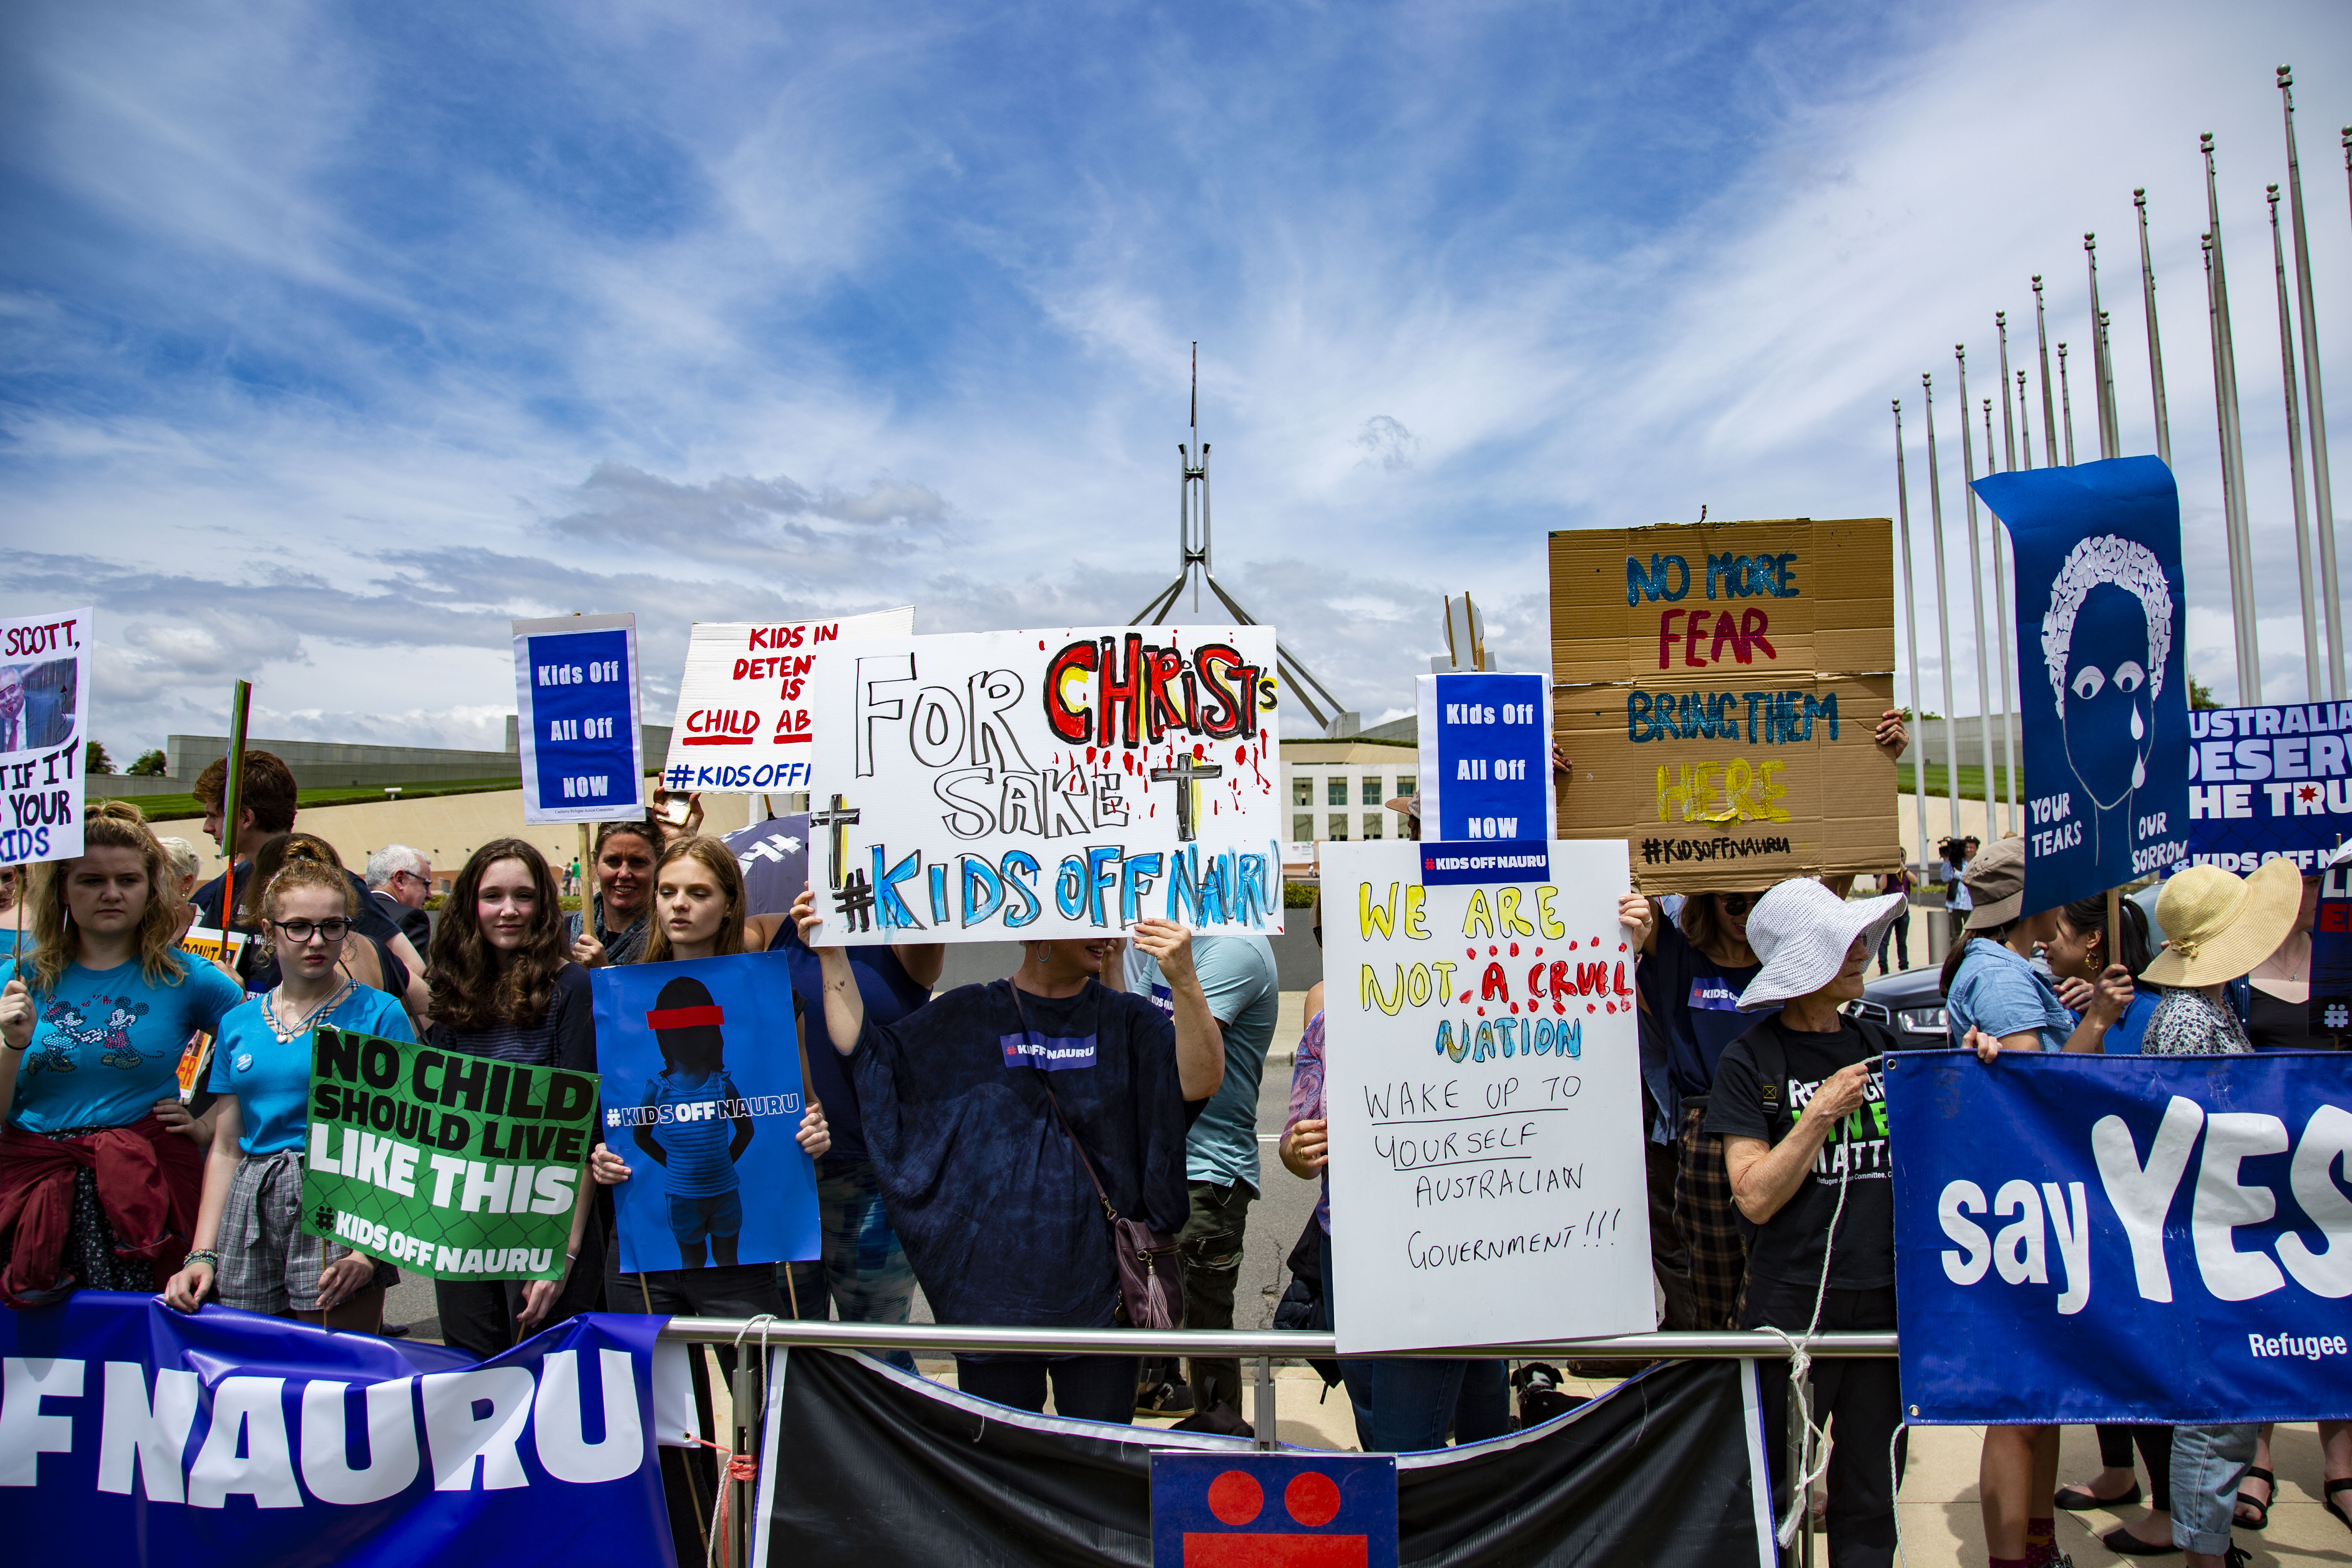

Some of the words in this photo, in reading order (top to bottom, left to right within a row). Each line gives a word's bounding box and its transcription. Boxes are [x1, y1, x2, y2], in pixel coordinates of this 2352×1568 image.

[1626, 552, 1691, 608] NO
[1707, 551, 1800, 600] MORE
[5, 619, 81, 656] SCOTT,
[749, 626, 806, 651] KIDS
[814, 624, 838, 645] IN
[1659, 607, 1777, 670] FEAR
[539, 664, 582, 686] Kids
[589, 661, 619, 683] Off
[733, 655, 816, 680] DETEN
[780, 678, 805, 701] IS
[551, 720, 577, 741] All
[584, 718, 612, 739] Off
[687, 709, 760, 735] CHILD
[776, 709, 811, 733] AB
[854, 652, 1040, 779] FOR
[1447, 704, 1495, 724] Kids
[1503, 703, 1534, 724] Off
[12, 759, 36, 790] IF
[43, 735, 79, 785] IT
[1457, 759, 1489, 780] All
[1494, 759, 1525, 780] Off
[563, 776, 608, 797] NOW
[934, 765, 1129, 841] SAKE
[1656, 758, 1791, 824] HERE
[10, 790, 71, 828] YOUR
[2030, 793, 2071, 824] YOUR
[2139, 812, 2167, 840] OUR
[1469, 817, 1518, 839] NOW
[2032, 820, 2082, 857] TEARS
[2132, 840, 2188, 874] SORROW
[1055, 845, 1163, 930] OFF
[1167, 838, 1281, 931] NAURU
[1359, 881, 1432, 941] WE
[1462, 885, 1566, 940] ARE
[1359, 960, 1457, 1016] NOT
[1481, 962, 1509, 1004] A
[1528, 960, 1634, 998] CRUEL
[1436, 1017, 1582, 1063] NATION
[316, 1030, 400, 1090] NO
[412, 1050, 594, 1121] CHILD
[1364, 1081, 1459, 1120] WAKE
[1487, 1077, 1518, 1110] UP
[1545, 1076, 1581, 1099] TO
[313, 1084, 470, 1151] SHOULD
[480, 1121, 587, 1162] LIVE
[1375, 1122, 1538, 1170] YOURSELF
[309, 1123, 420, 1198] LIKE
[430, 1153, 578, 1215] THIS
[1416, 1163, 1584, 1208] AUSTRALIAN
[1817, 1177, 1838, 1185] Refugee
[1938, 1179, 2090, 1315] say
[2248, 1332, 2347, 1361] Refugee
